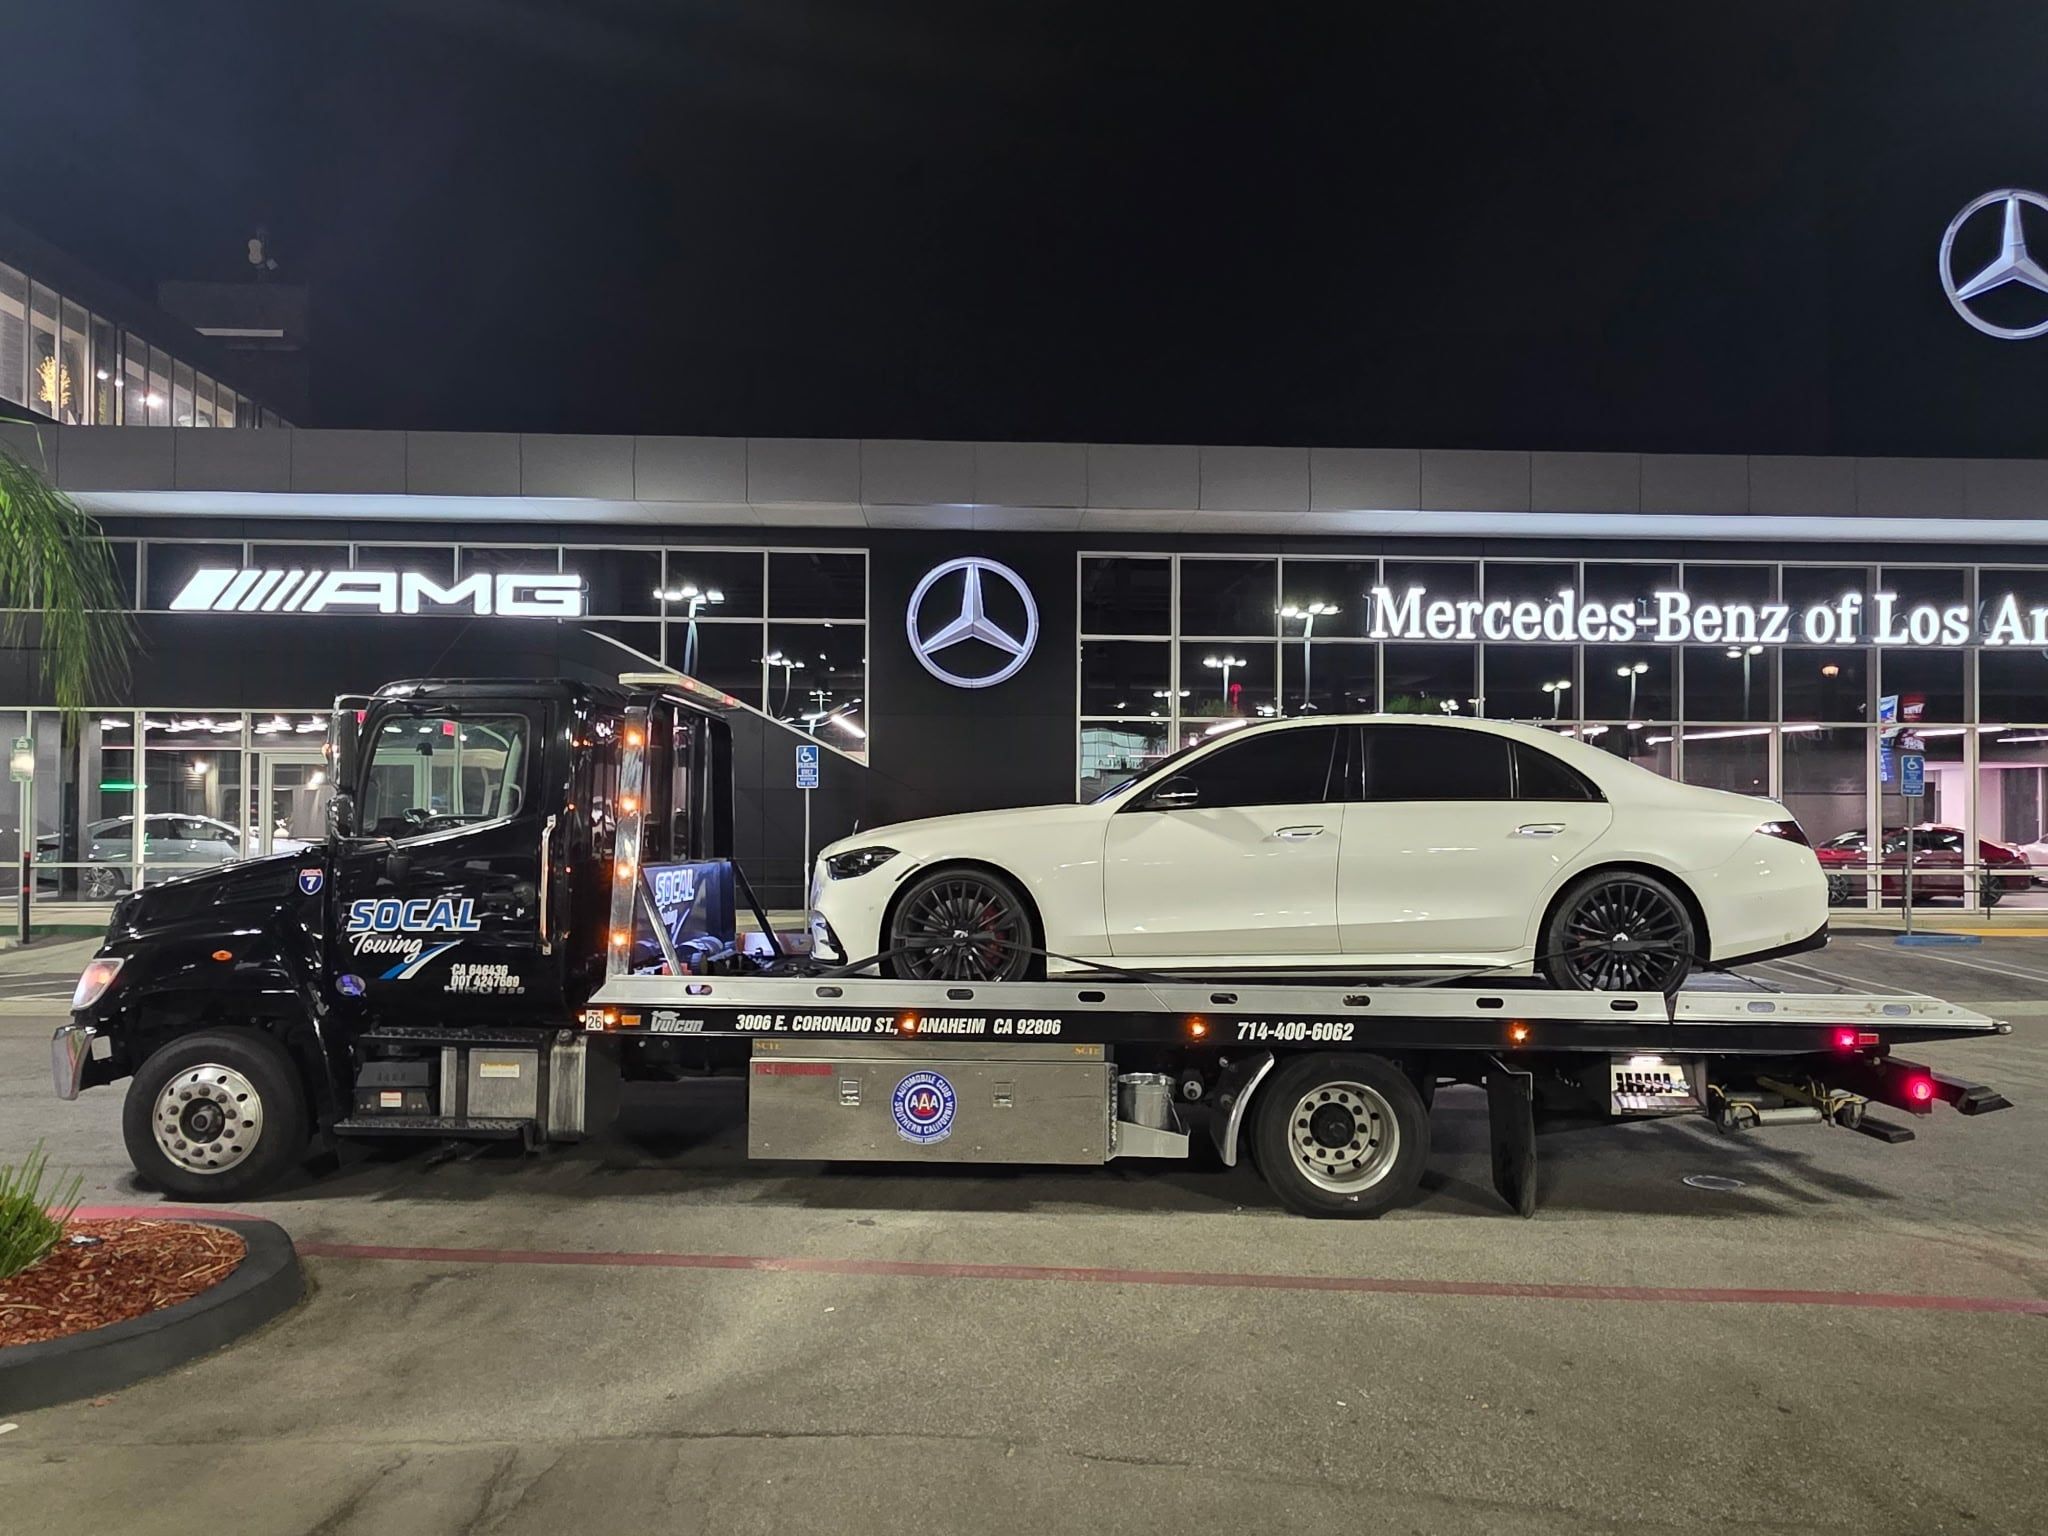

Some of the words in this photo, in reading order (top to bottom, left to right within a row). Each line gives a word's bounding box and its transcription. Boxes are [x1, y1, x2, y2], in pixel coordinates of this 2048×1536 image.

[301, 571, 583, 616] AMG
[1370, 587, 1789, 643] Mercedes-Benz
[1804, 592, 1862, 644] of
[1873, 593, 1970, 645] Los
[306, 876, 317, 889] 7
[655, 869, 694, 906] SOCAL
[346, 898, 482, 931] SOCAL
[349, 931, 423, 963] Towing
[452, 964, 466, 976] CA
[588, 1016, 602, 1029] 26
[736, 1015, 771, 1031] 3006
[774, 1015, 788, 1031] E.
[792, 1016, 872, 1032] CORONADO
[917, 1018, 986, 1034] ANAHEIM
[993, 1019, 1013, 1034] CA
[1016, 1019, 1062, 1035] 92806
[1237, 1022, 1355, 1041] 714-400-6062
[896, 1074, 937, 1098] AUTOMOBILE
[936, 1080, 952, 1098] CLUB
[910, 1093, 939, 1110] AAA
[894, 1101, 921, 1134] SOUTHERN
[923, 1101, 953, 1134] CALIFORNIA
